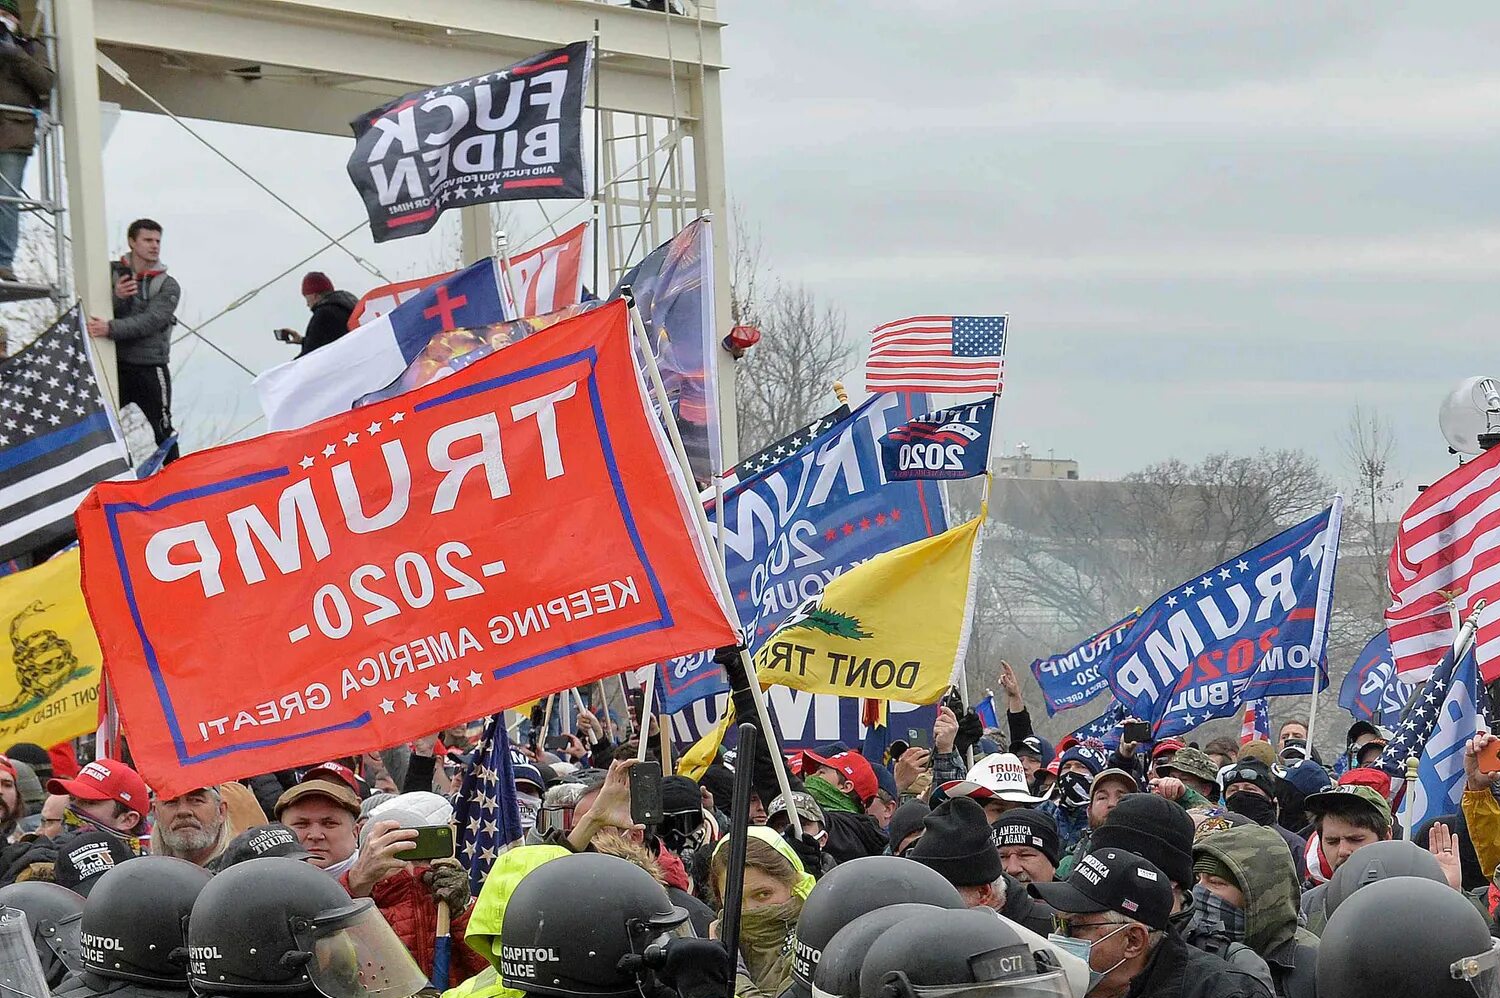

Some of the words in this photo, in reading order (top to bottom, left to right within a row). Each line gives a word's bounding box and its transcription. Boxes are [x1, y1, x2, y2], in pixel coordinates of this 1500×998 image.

[996, 772, 1023, 783] 2020
[999, 825, 1032, 836] AMERICA
[252, 834, 294, 855] TRUMP
[1004, 834, 1026, 844] AGAIN
[503, 945, 560, 963] CAPITOL
